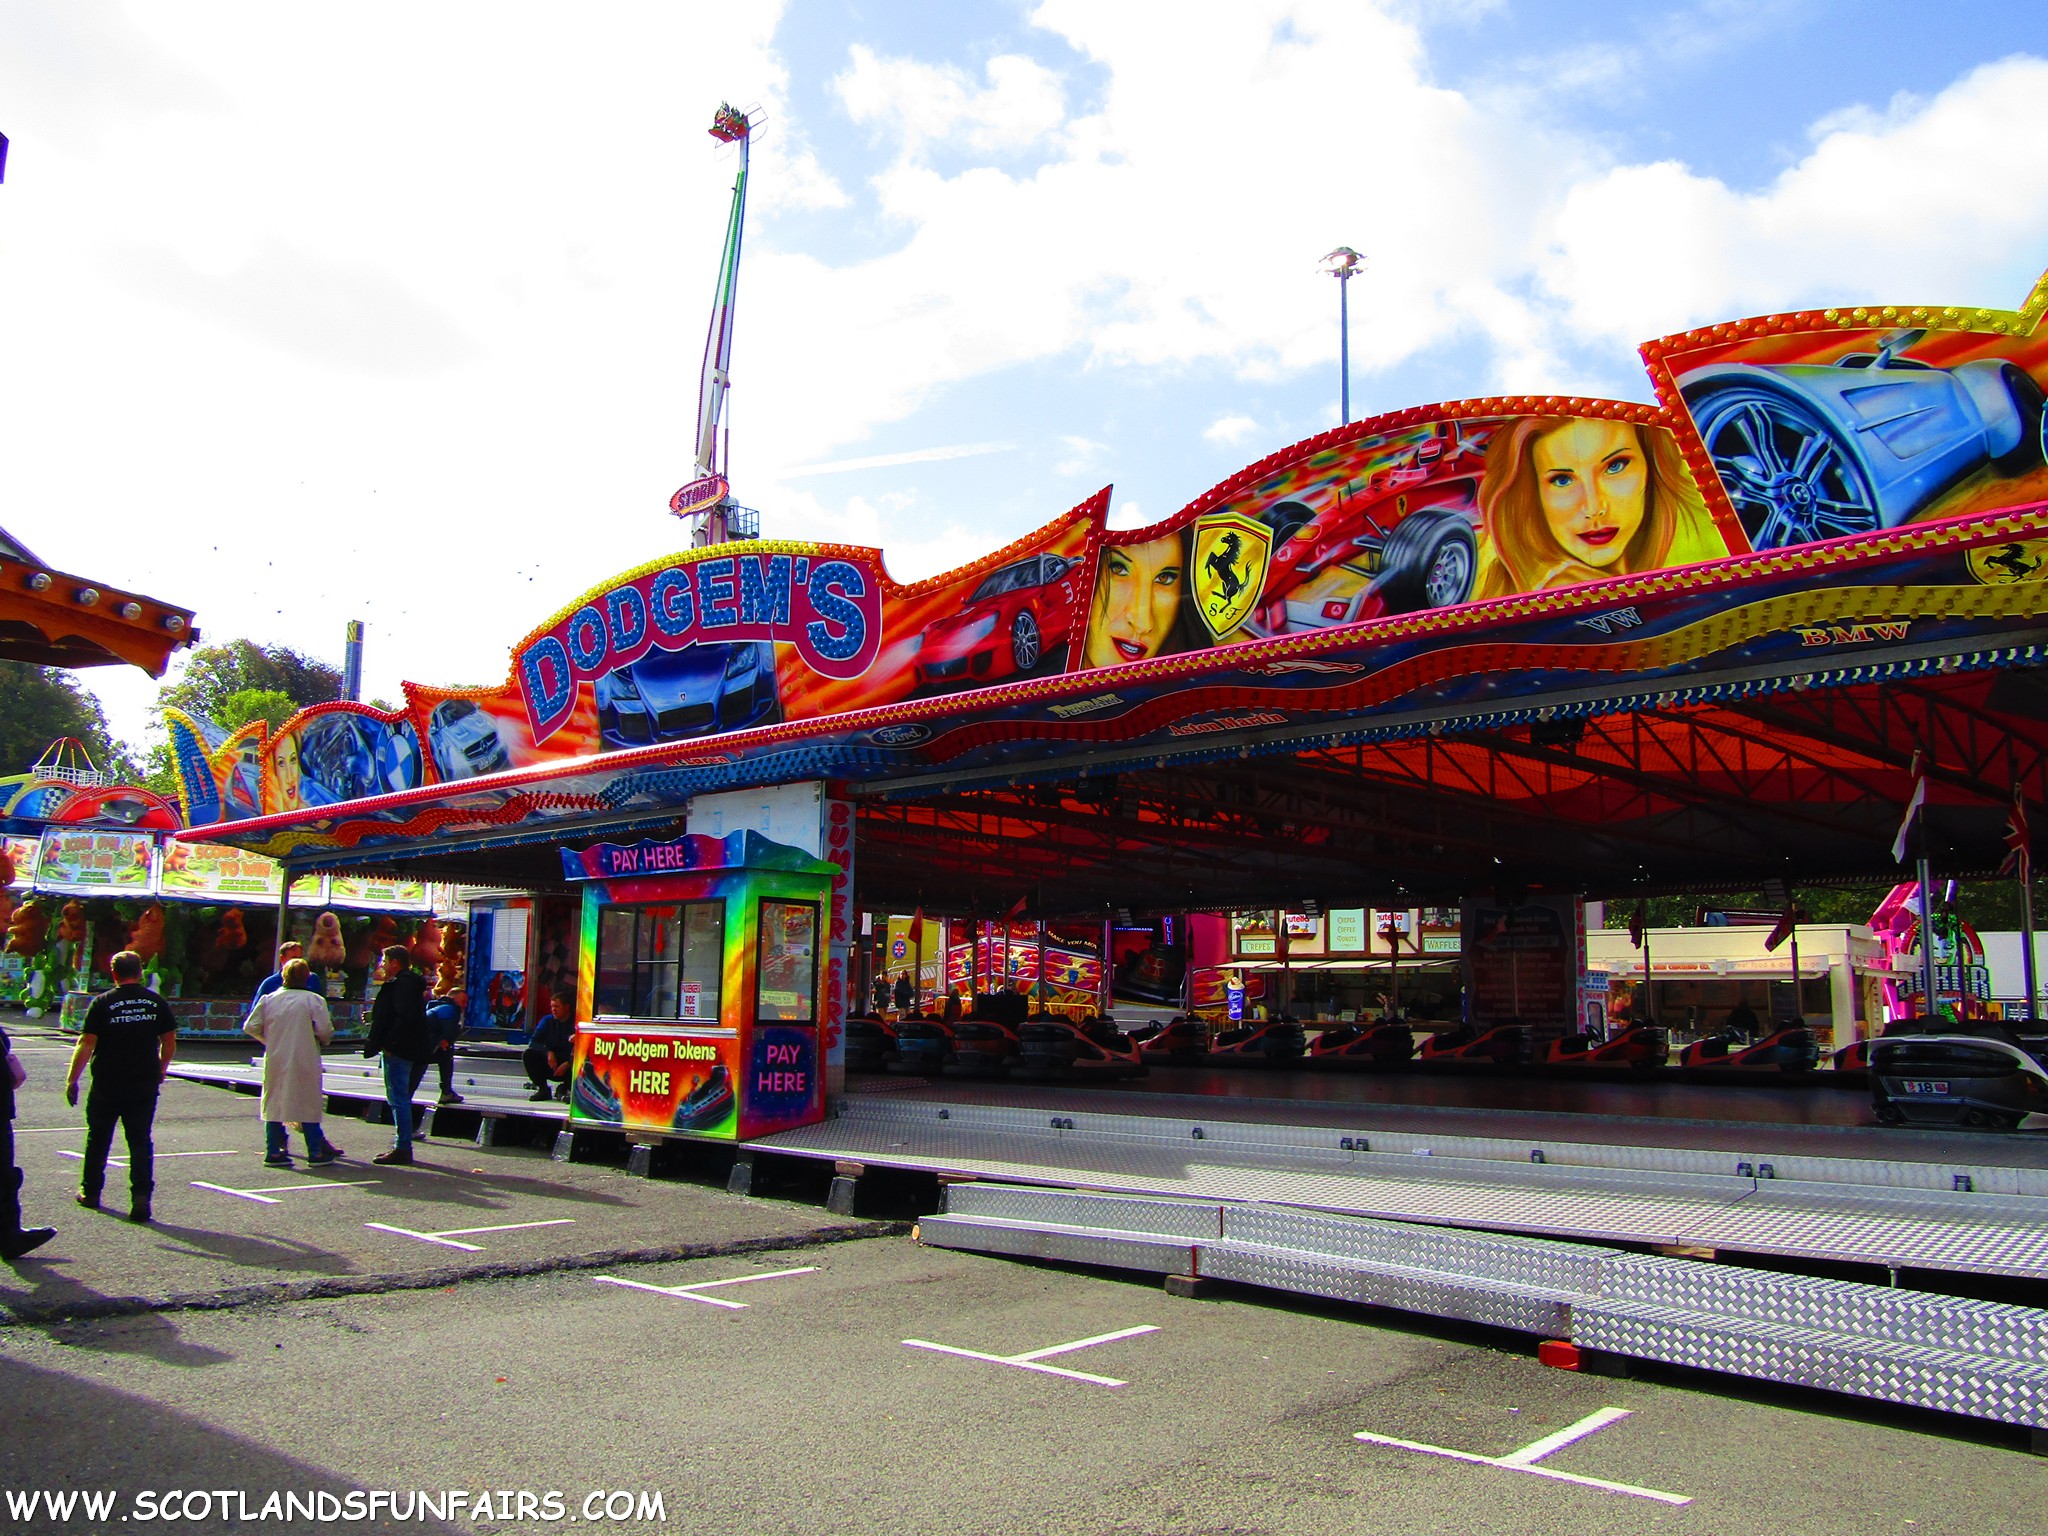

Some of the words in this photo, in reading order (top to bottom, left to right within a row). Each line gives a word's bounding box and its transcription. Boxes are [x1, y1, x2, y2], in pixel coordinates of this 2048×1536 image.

[678, 479, 718, 510] STORM
[1581, 607, 1643, 635] VW
[520, 555, 865, 727] DODGEM'S
[1796, 621, 1912, 647] BMW
[881, 727, 922, 744] Ford
[1169, 721, 1223, 737] Aston
[1215, 712, 1289, 731] Martin
[612, 849, 639, 872] PAY
[643, 845, 685, 869] HERE
[828, 803, 851, 942] BUMPER
[1377, 914, 1403, 922] nutela
[1047, 930, 1065, 944] MAKE
[1245, 942, 1271, 951] CREPES
[827, 957, 843, 1050] CARS
[110, 1014, 157, 1023] ATTENDANT
[594, 1037, 616, 1060] Buy
[618, 1038, 669, 1062] Dodgem
[672, 1039, 717, 1061] Tokens
[766, 1044, 801, 1065] PAY
[630, 1069, 671, 1095] HERE
[758, 1071, 806, 1093] HERE
[1917, 1082, 1933, 1093] 18
